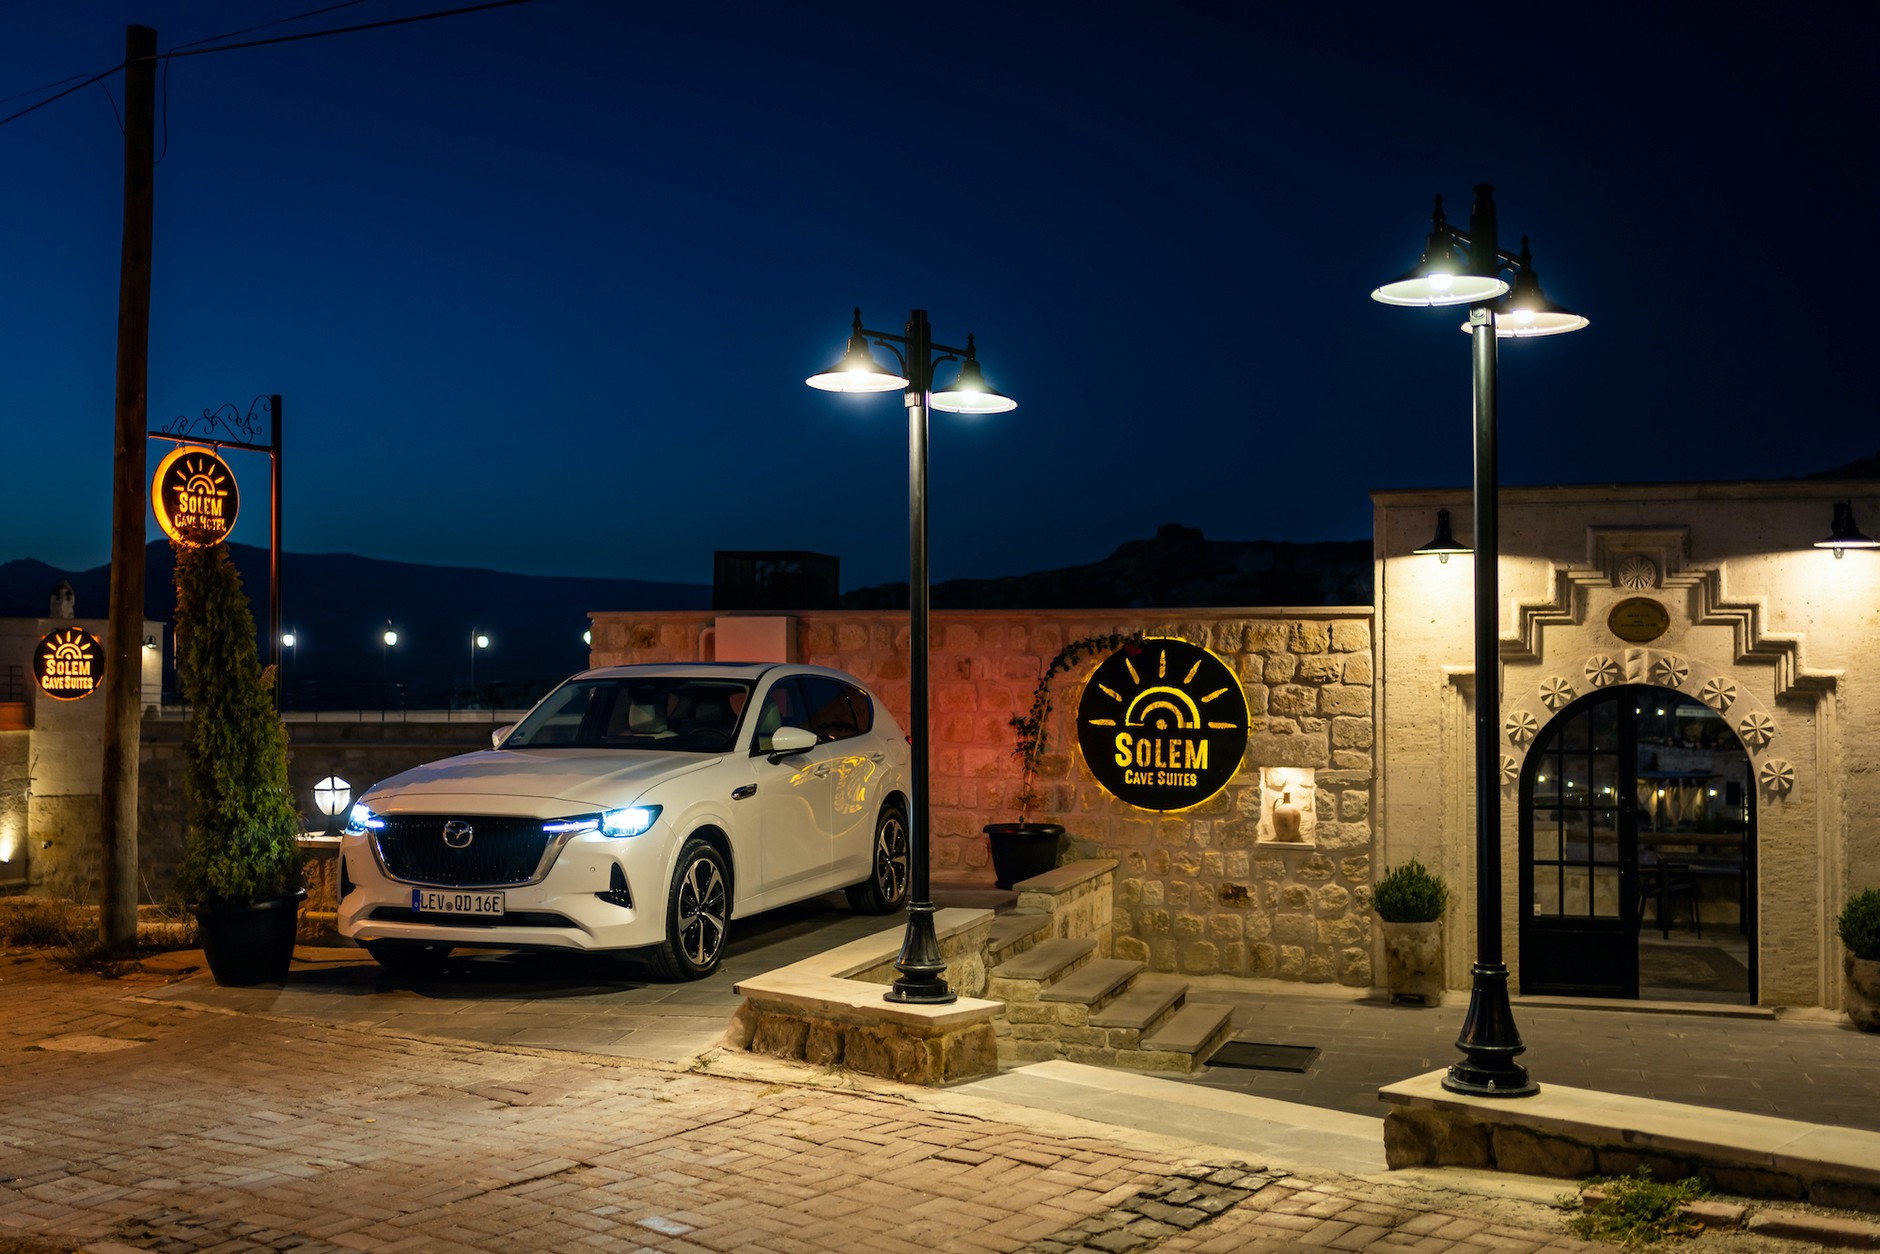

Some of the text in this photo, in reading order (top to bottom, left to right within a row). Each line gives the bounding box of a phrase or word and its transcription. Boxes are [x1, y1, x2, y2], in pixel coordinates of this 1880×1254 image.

[179, 491, 223, 517] SOLEM
[174, 513, 227, 532] CAVE HOTEL
[46, 659, 91, 676] SOLEM
[41, 675, 94, 690] CAVE SUITES
[1114, 731, 1209, 770] SOLEM
[1124, 769, 1198, 787] CAVE SUITES
[420, 892, 500, 913] LEV QD 16E
